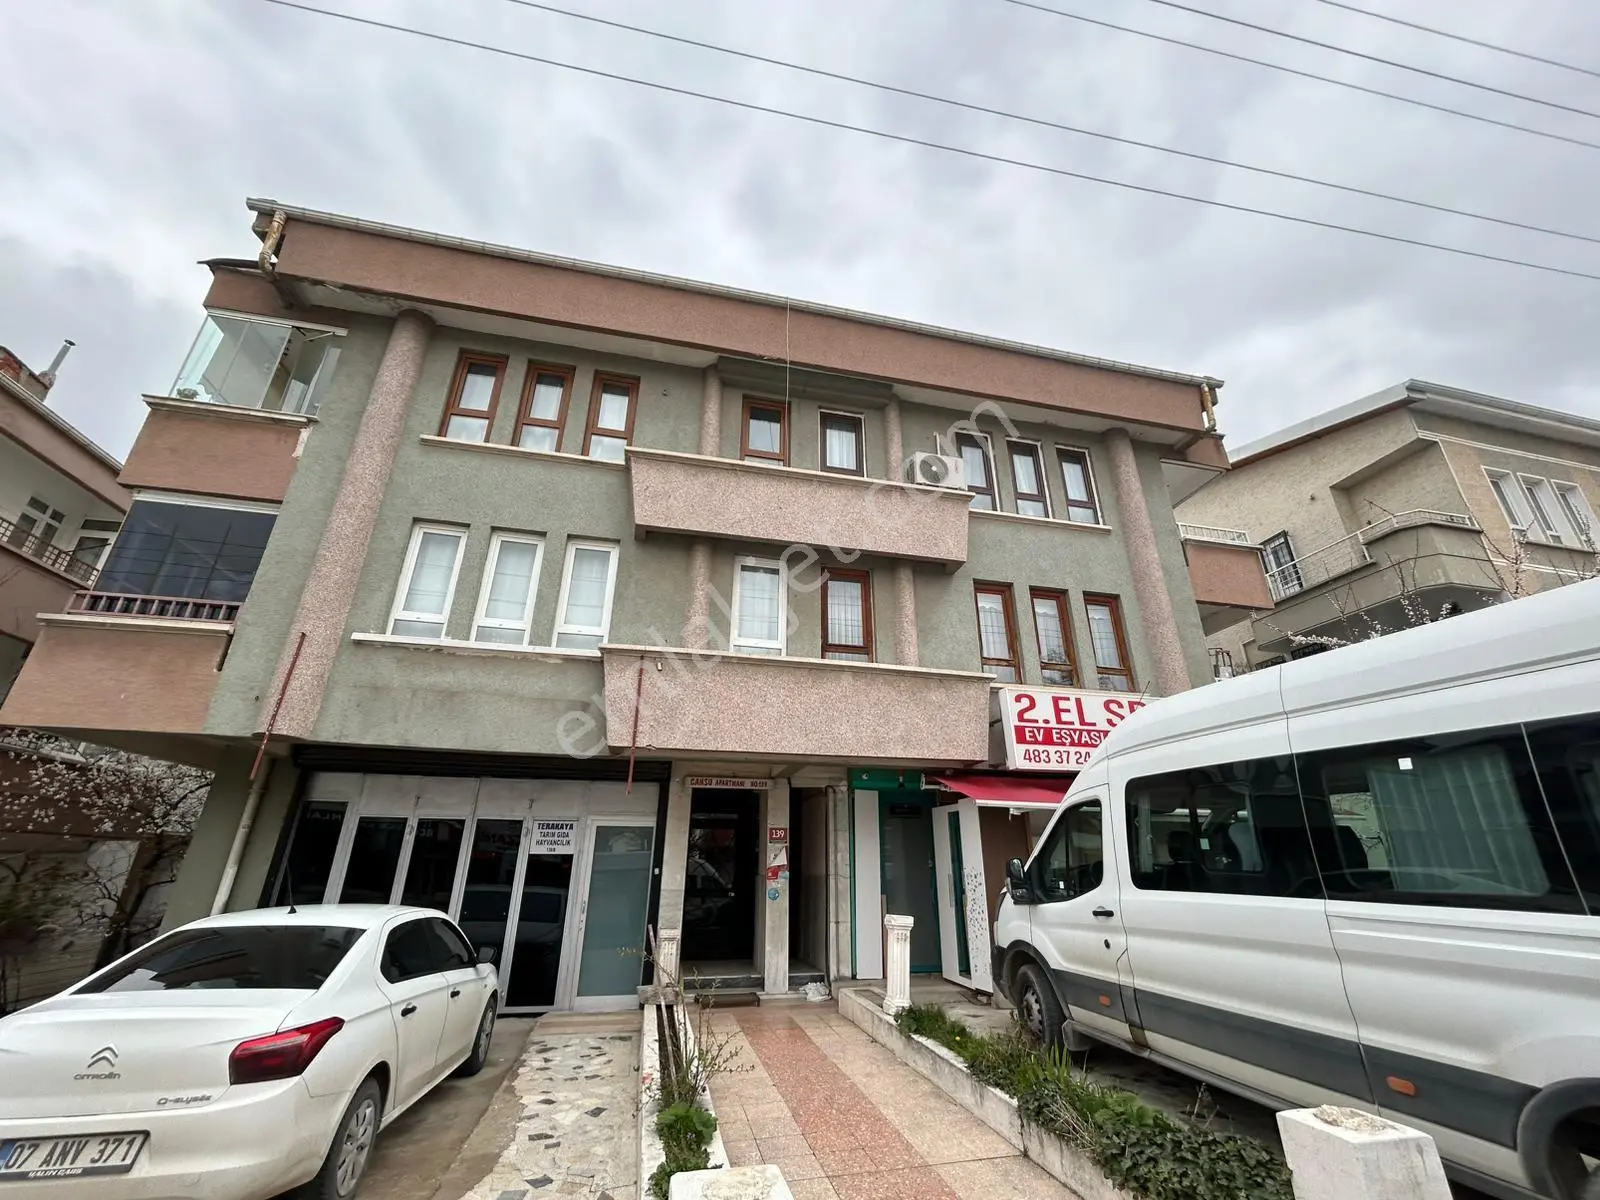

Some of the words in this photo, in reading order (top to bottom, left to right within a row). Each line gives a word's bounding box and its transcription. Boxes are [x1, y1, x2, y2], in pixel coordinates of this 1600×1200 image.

[1014, 693, 1097, 726] 2.EL
[1025, 728, 1043, 742] EV
[1023, 749, 1051, 764] 483
[1055, 750, 1070, 765] 37
[537, 822, 574, 831] TERAKAYA
[772, 829, 785, 838] 139
[4, 1143, 40, 1169] 07
[38, 1139, 90, 1168] ANV
[90, 1136, 138, 1164] 371
